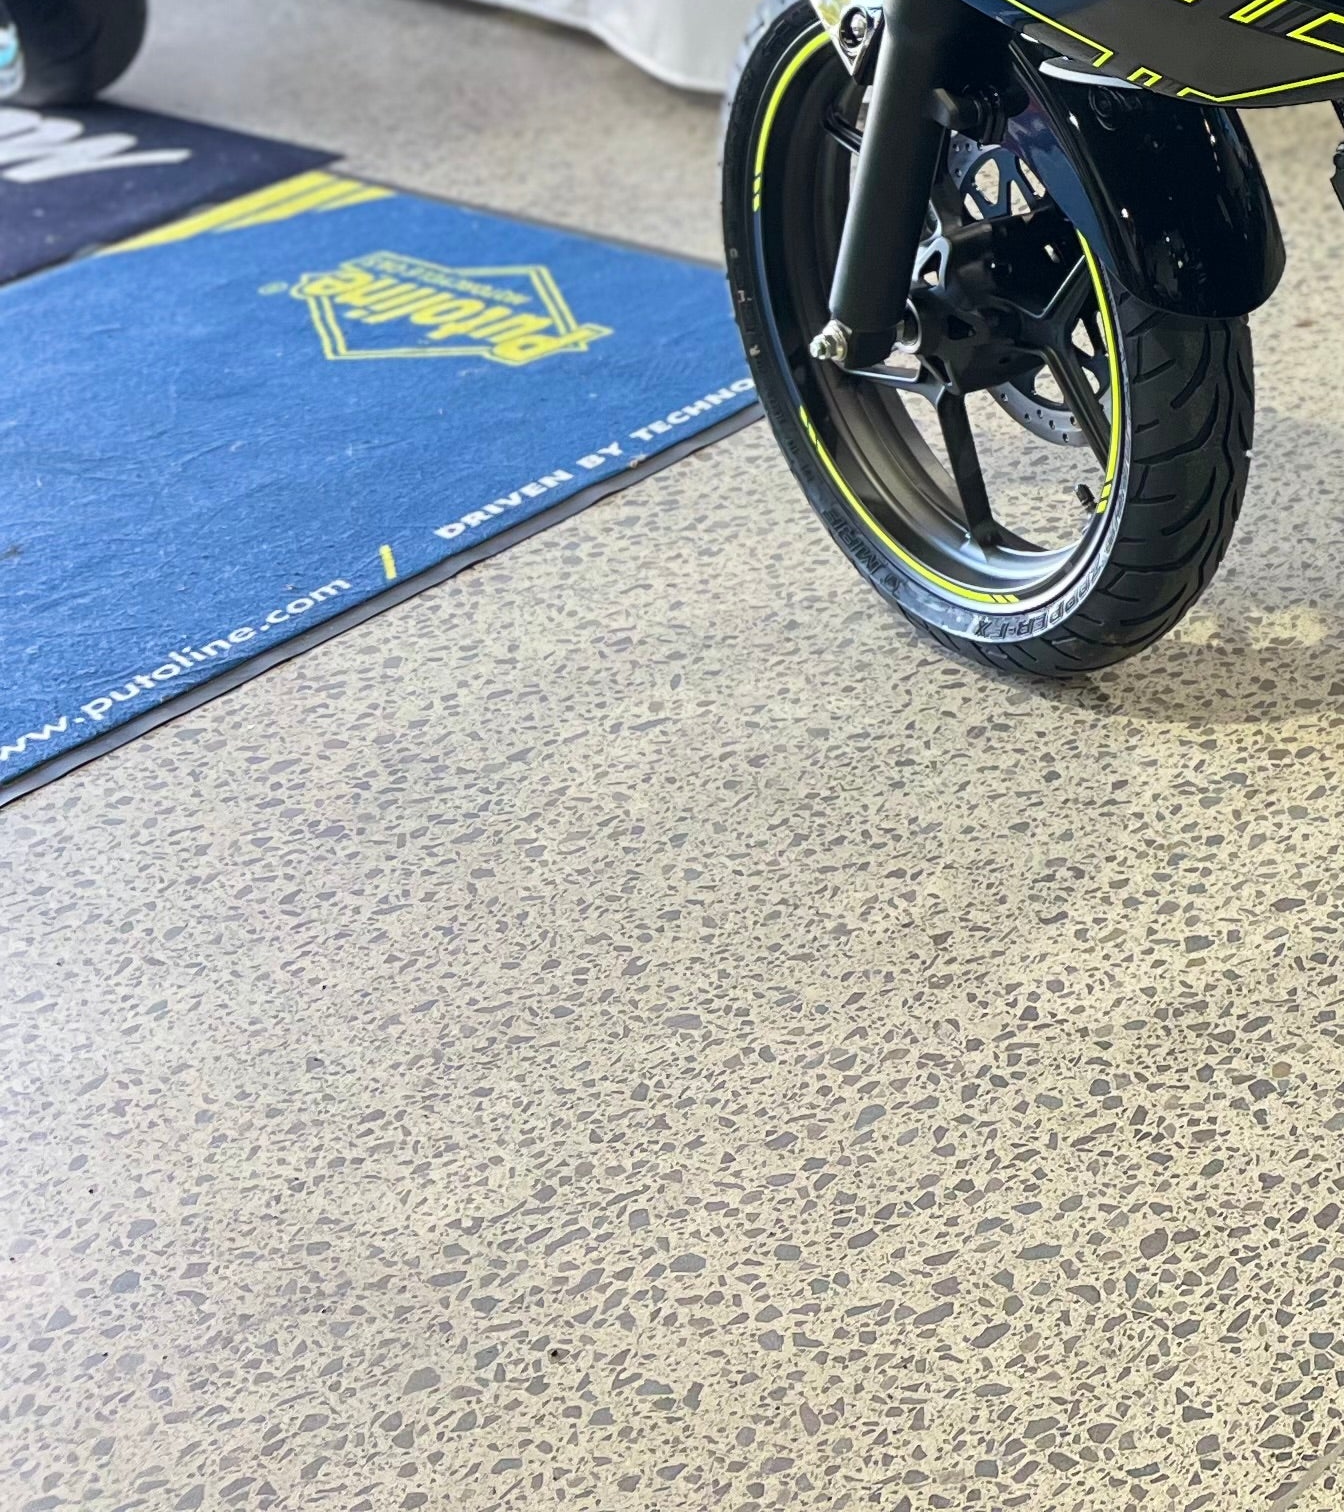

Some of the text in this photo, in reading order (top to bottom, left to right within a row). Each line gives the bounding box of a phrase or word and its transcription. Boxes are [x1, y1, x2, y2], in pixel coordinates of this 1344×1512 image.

[296, 262, 612, 365] Putoline
[434, 469, 574, 539] DRIVEN
[576, 441, 624, 470] BY
